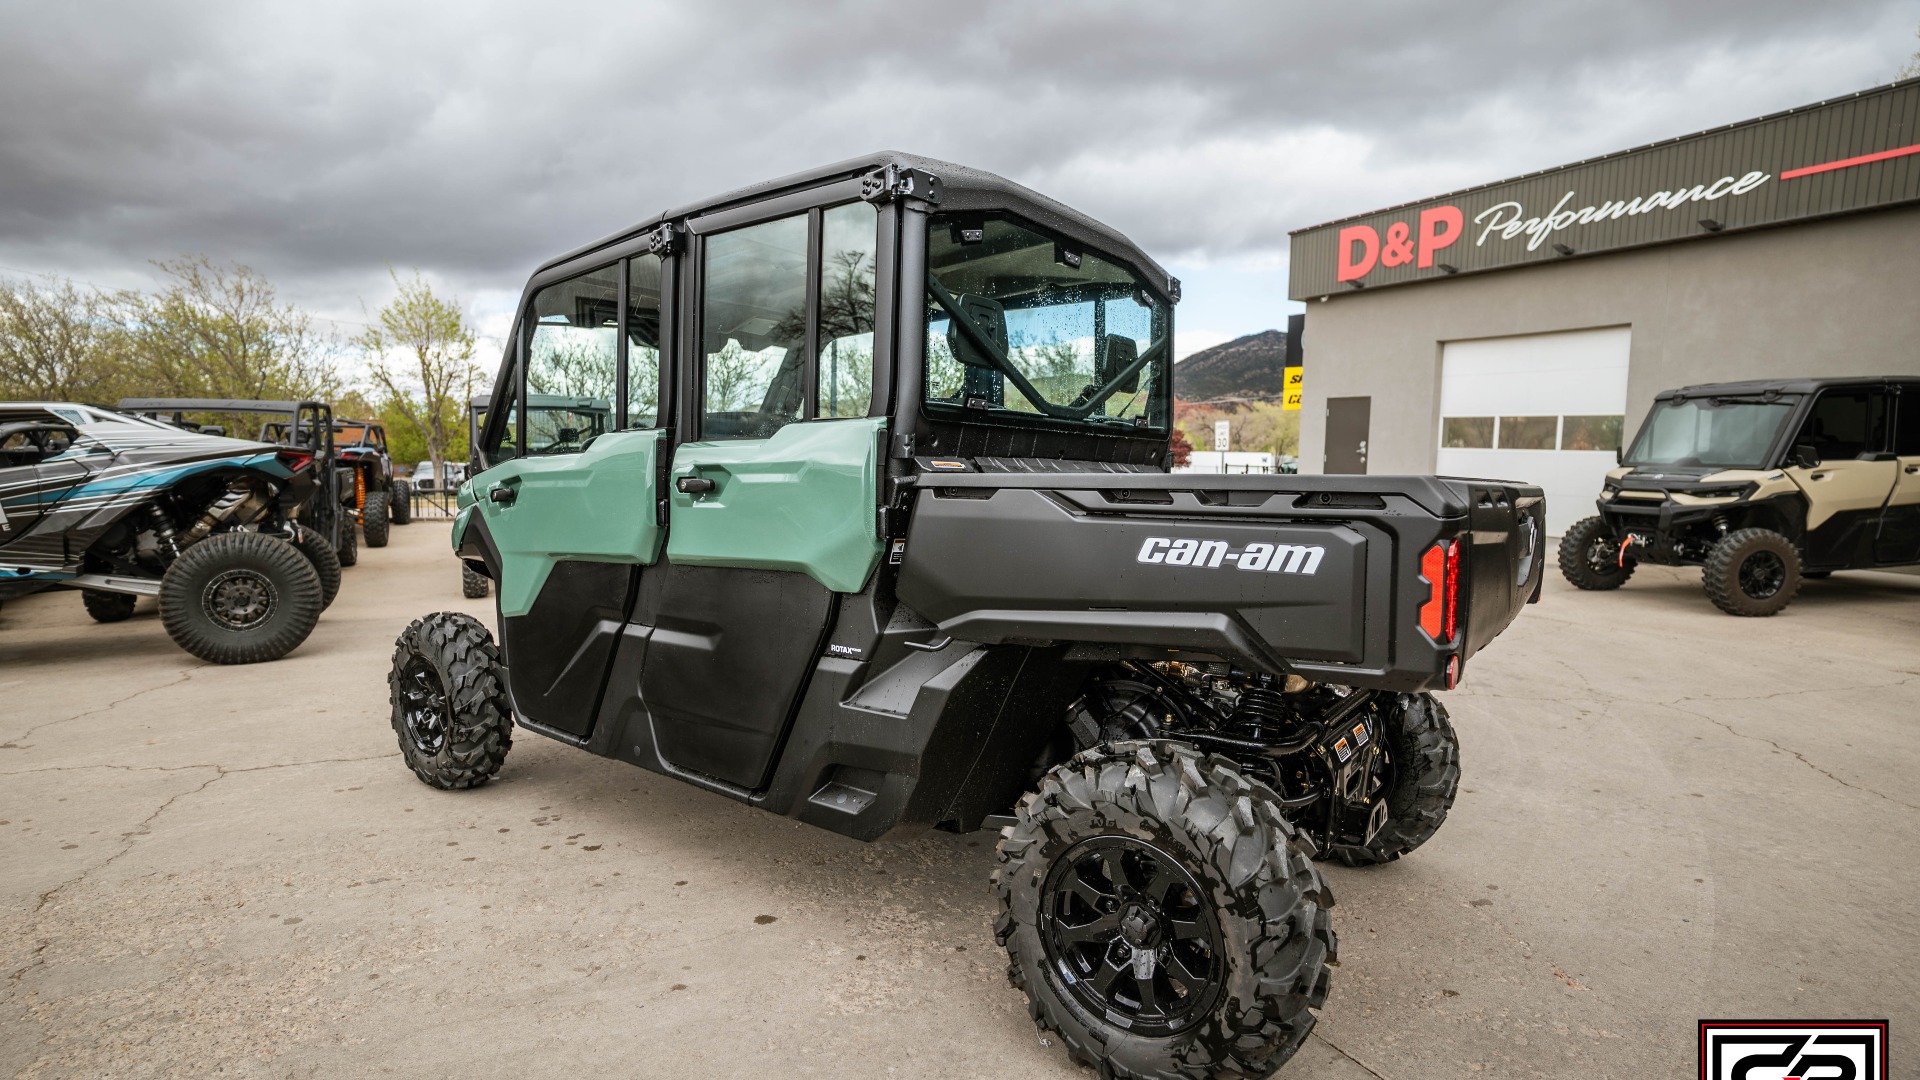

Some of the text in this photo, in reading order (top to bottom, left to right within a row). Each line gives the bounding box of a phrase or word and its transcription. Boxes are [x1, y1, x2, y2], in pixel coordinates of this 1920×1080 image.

[1337, 170, 1771, 283] D&P Performance
[1217, 437, 1228, 448] 30
[1137, 537, 1325, 575] can-am
[831, 644, 853, 654] ROTAX
